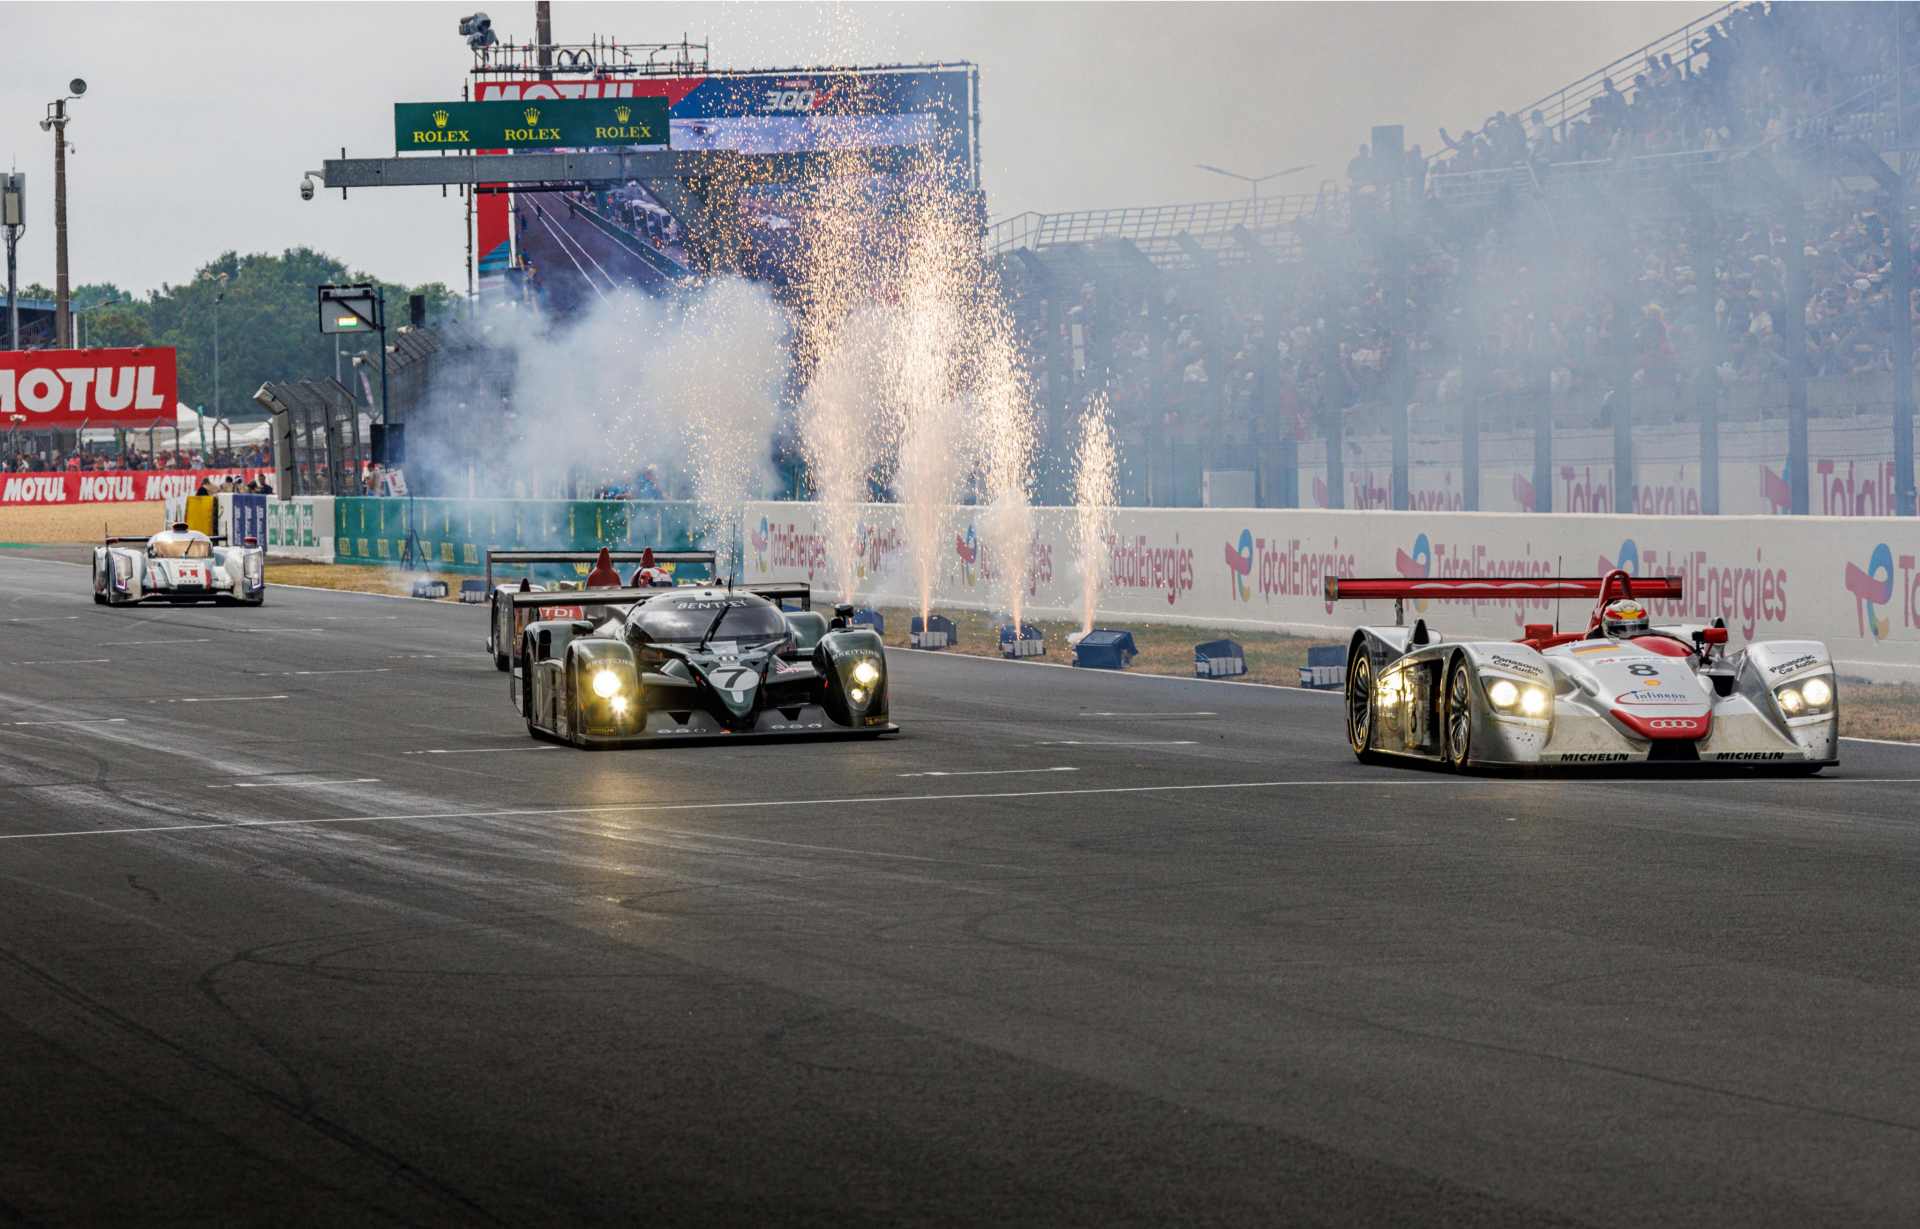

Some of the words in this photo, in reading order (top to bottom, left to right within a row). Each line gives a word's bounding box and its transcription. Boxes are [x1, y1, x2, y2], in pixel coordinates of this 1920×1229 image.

[413, 130, 471, 143] ROLEX
[504, 128, 561, 141] ROLEX
[595, 126, 653, 139] ROLEX
[3, 477, 66, 501] MOTUL
[79, 476, 135, 501] MOTUL
[145, 475, 197, 501] MOTUL
[1256, 536, 1355, 615] TotalEnergies
[1643, 547, 1787, 641] TotalEnergies
[677, 600, 748, 610] BENTLEY
[542, 607, 574, 618] TDI
[1491, 655, 1544, 673] Panasonic
[1627, 664, 1659, 676] 8
[716, 668, 749, 689] 7
[1561, 753, 1629, 761] MICHELIN
[1716, 752, 1784, 760] MICHELIN
